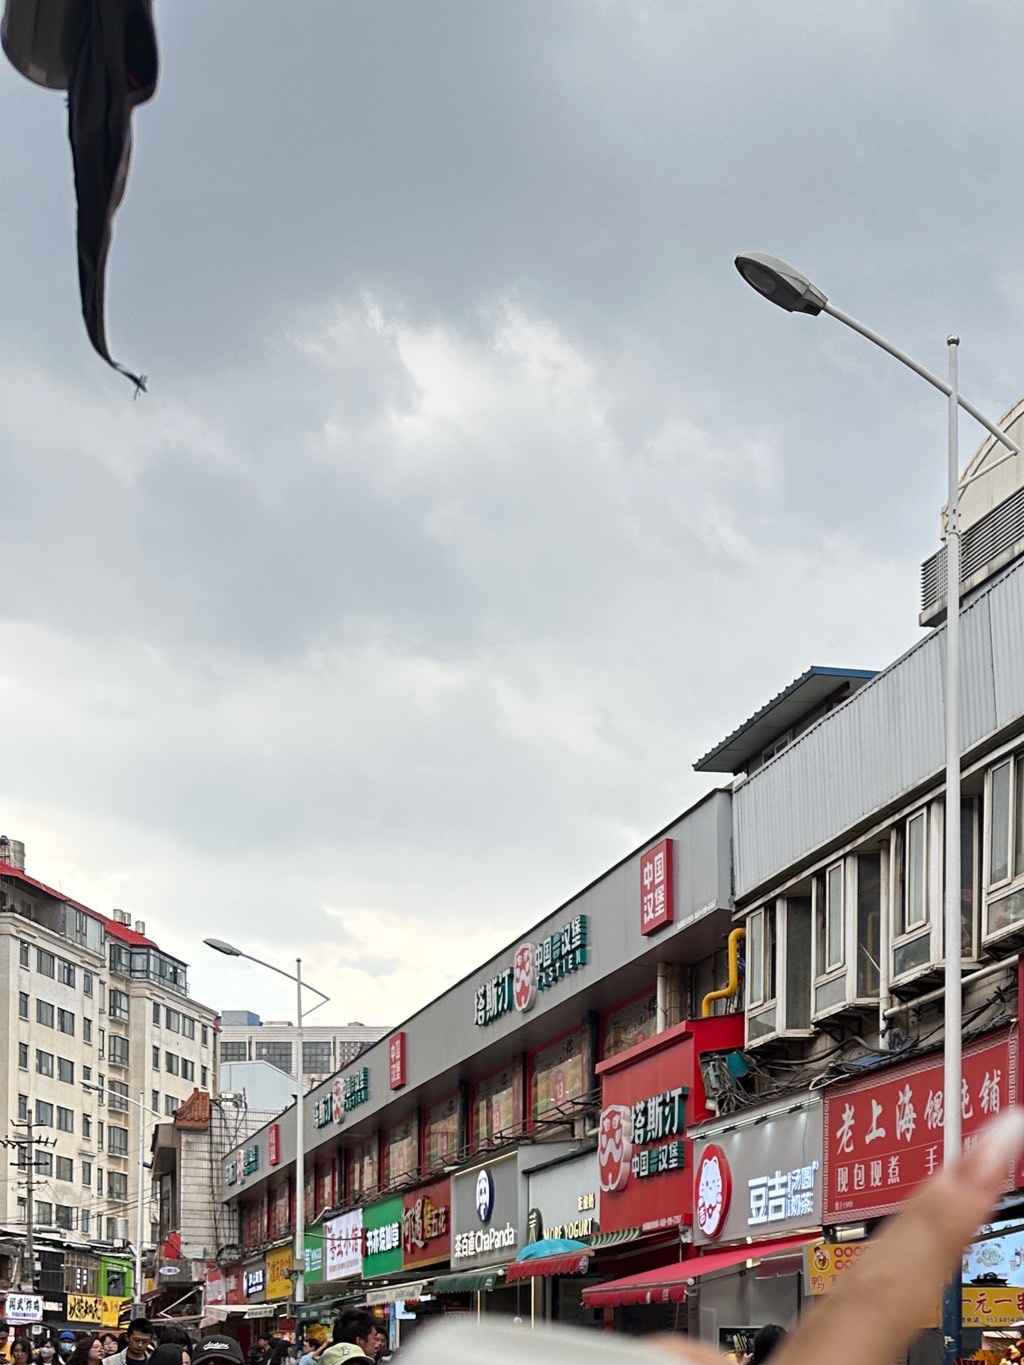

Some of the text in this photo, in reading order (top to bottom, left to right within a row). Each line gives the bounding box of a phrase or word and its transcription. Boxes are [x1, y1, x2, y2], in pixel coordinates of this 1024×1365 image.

[643, 851, 665, 890] 中国
[643, 885, 666, 924] 汉堡
[534, 915, 583, 967] 中国汉堡
[536, 950, 583, 987] TASTIEN
[474, 968, 512, 1025] 塔斯汀
[630, 1087, 684, 1144] 塔斯汀
[631, 1141, 680, 1178] 中国汉堡
[837, 1156, 900, 1192] 现包现煮
[748, 1171, 788, 1225] 豆吉
[454, 1222, 515, 1258] 茶百道 ChaPanda
[564, 1218, 593, 1239] YOGURT
